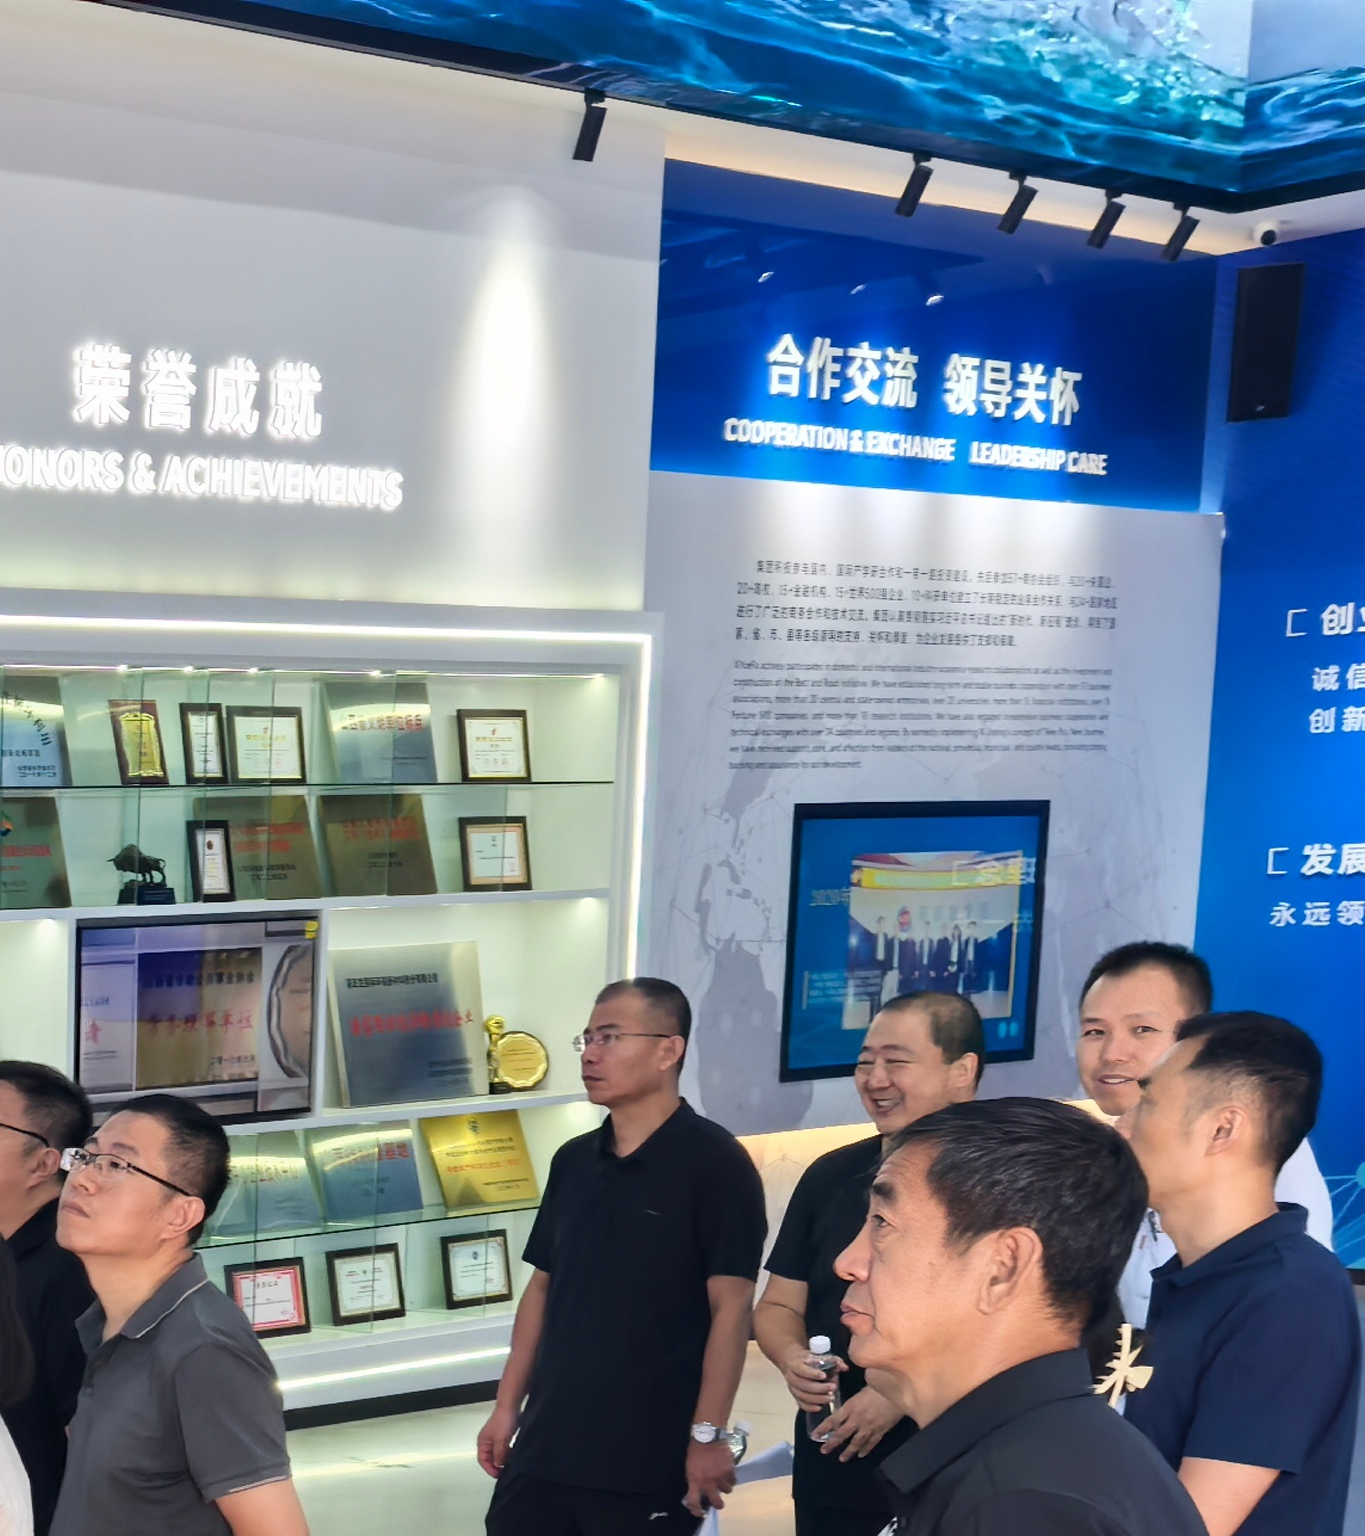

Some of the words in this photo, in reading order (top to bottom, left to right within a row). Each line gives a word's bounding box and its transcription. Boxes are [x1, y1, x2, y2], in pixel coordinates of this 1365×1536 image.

[72, 342, 324, 440] 荣誉成就
[766, 333, 919, 410] 合作交流
[943, 352, 1083, 427] 领导关怀
[723, 417, 848, 453] COOPERATION
[849, 430, 865, 453] &
[867, 431, 957, 462] EXCHANGE
[971, 440, 1066, 472] LEADERSHIP
[1067, 451, 1109, 476] CARE
[131, 452, 157, 494] &
[163, 454, 405, 511] ACHIEVEMENTS
[1321, 602, 1365, 637] 创
[1299, 842, 1365, 877] 发展
[1269, 899, 1365, 928] 永远领
